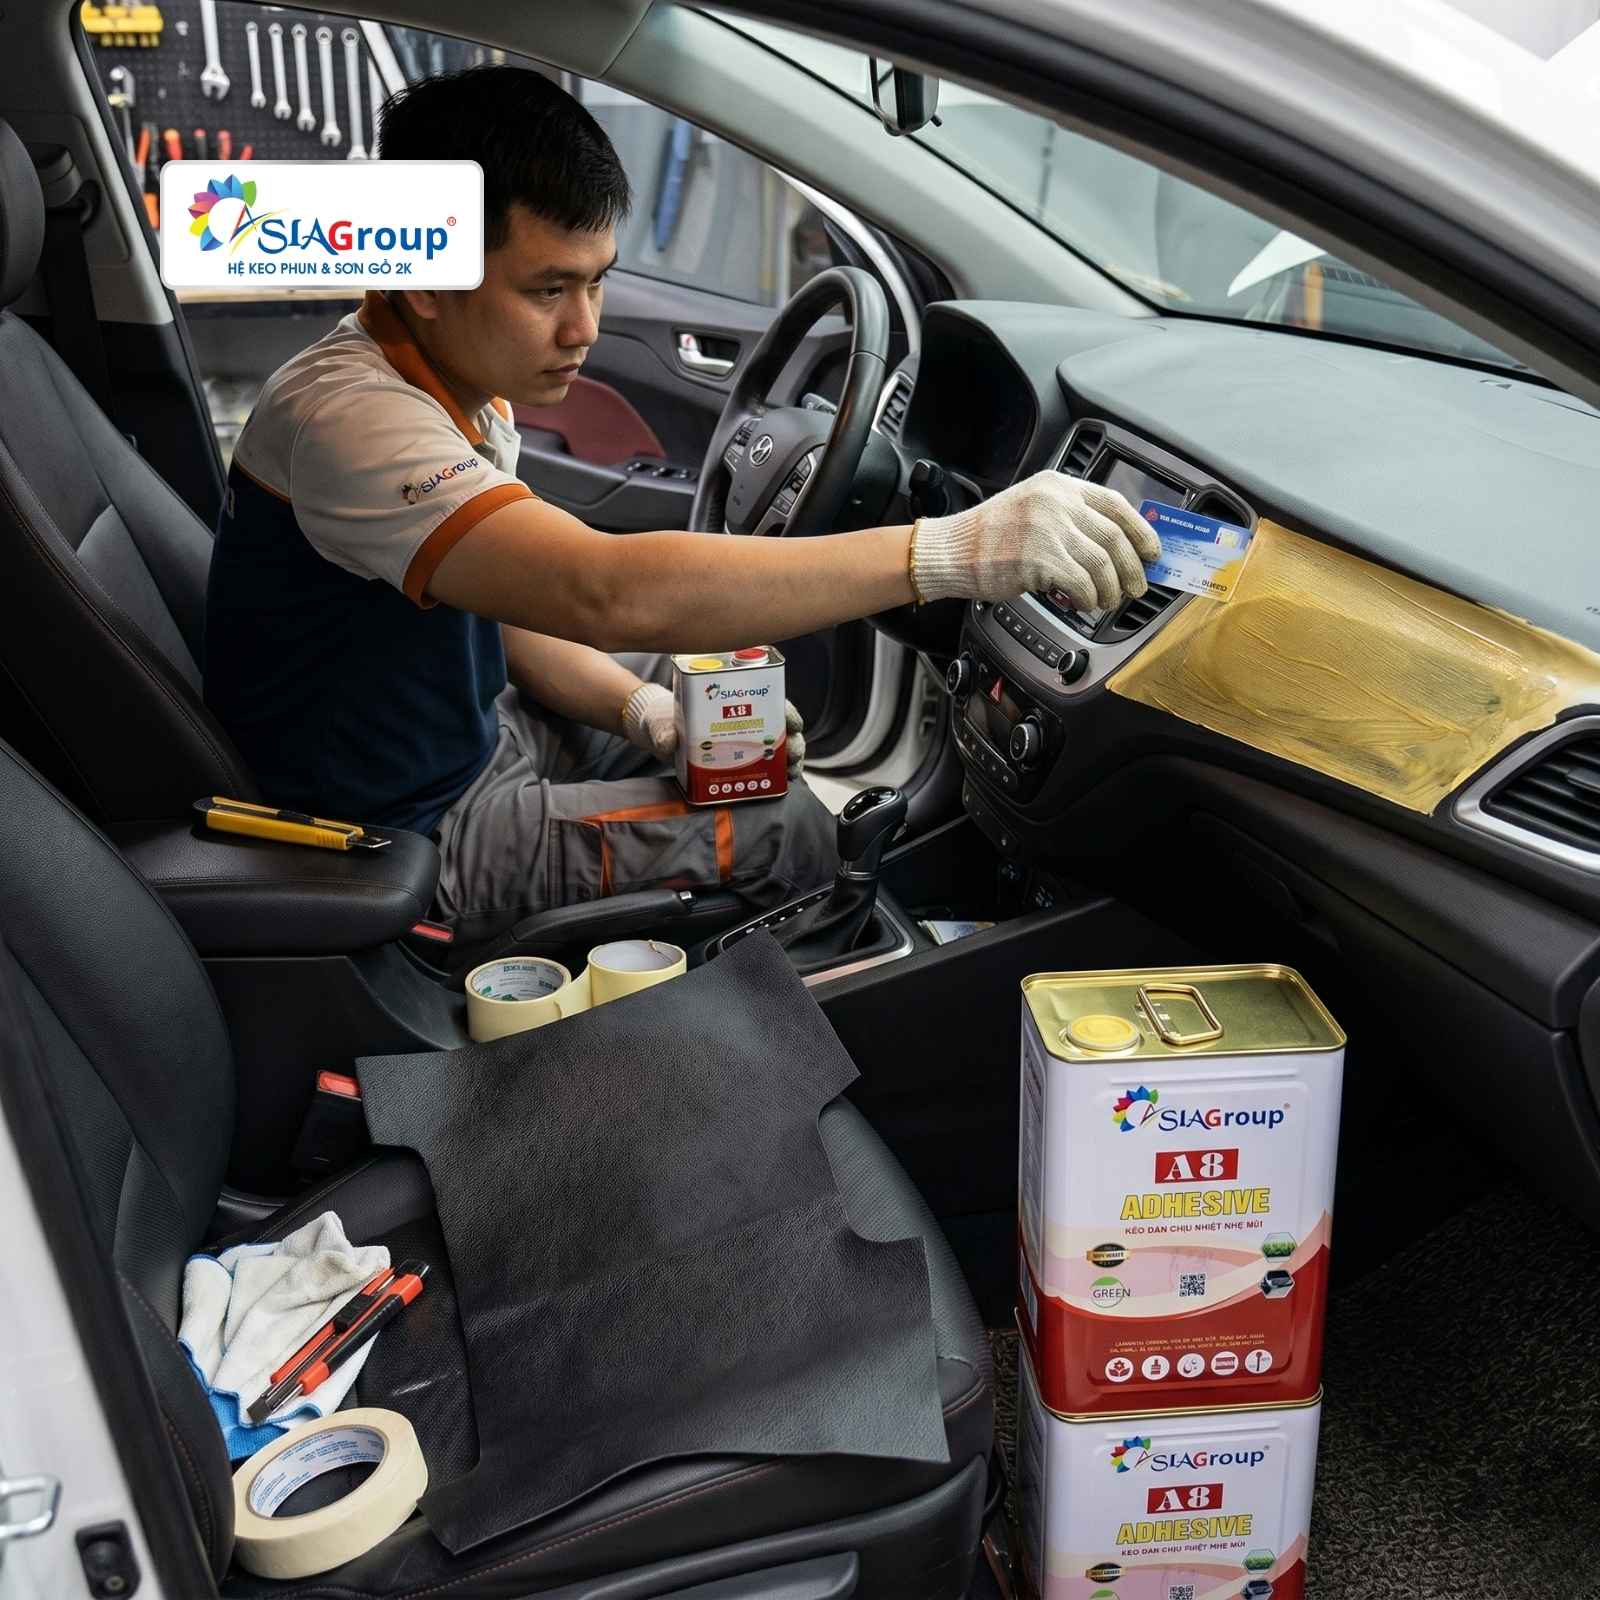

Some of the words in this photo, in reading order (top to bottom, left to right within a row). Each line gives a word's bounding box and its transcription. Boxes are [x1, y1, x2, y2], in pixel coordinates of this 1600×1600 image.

[727, 705, 747, 717] A8
[1164, 1152, 1224, 1181] A8
[1120, 1188, 1271, 1220] ADHESIVE
[1092, 1288, 1131, 1298] GREEN
[1155, 1487, 1210, 1512] A8
[1116, 1514, 1252, 1545] ADHESIVE
